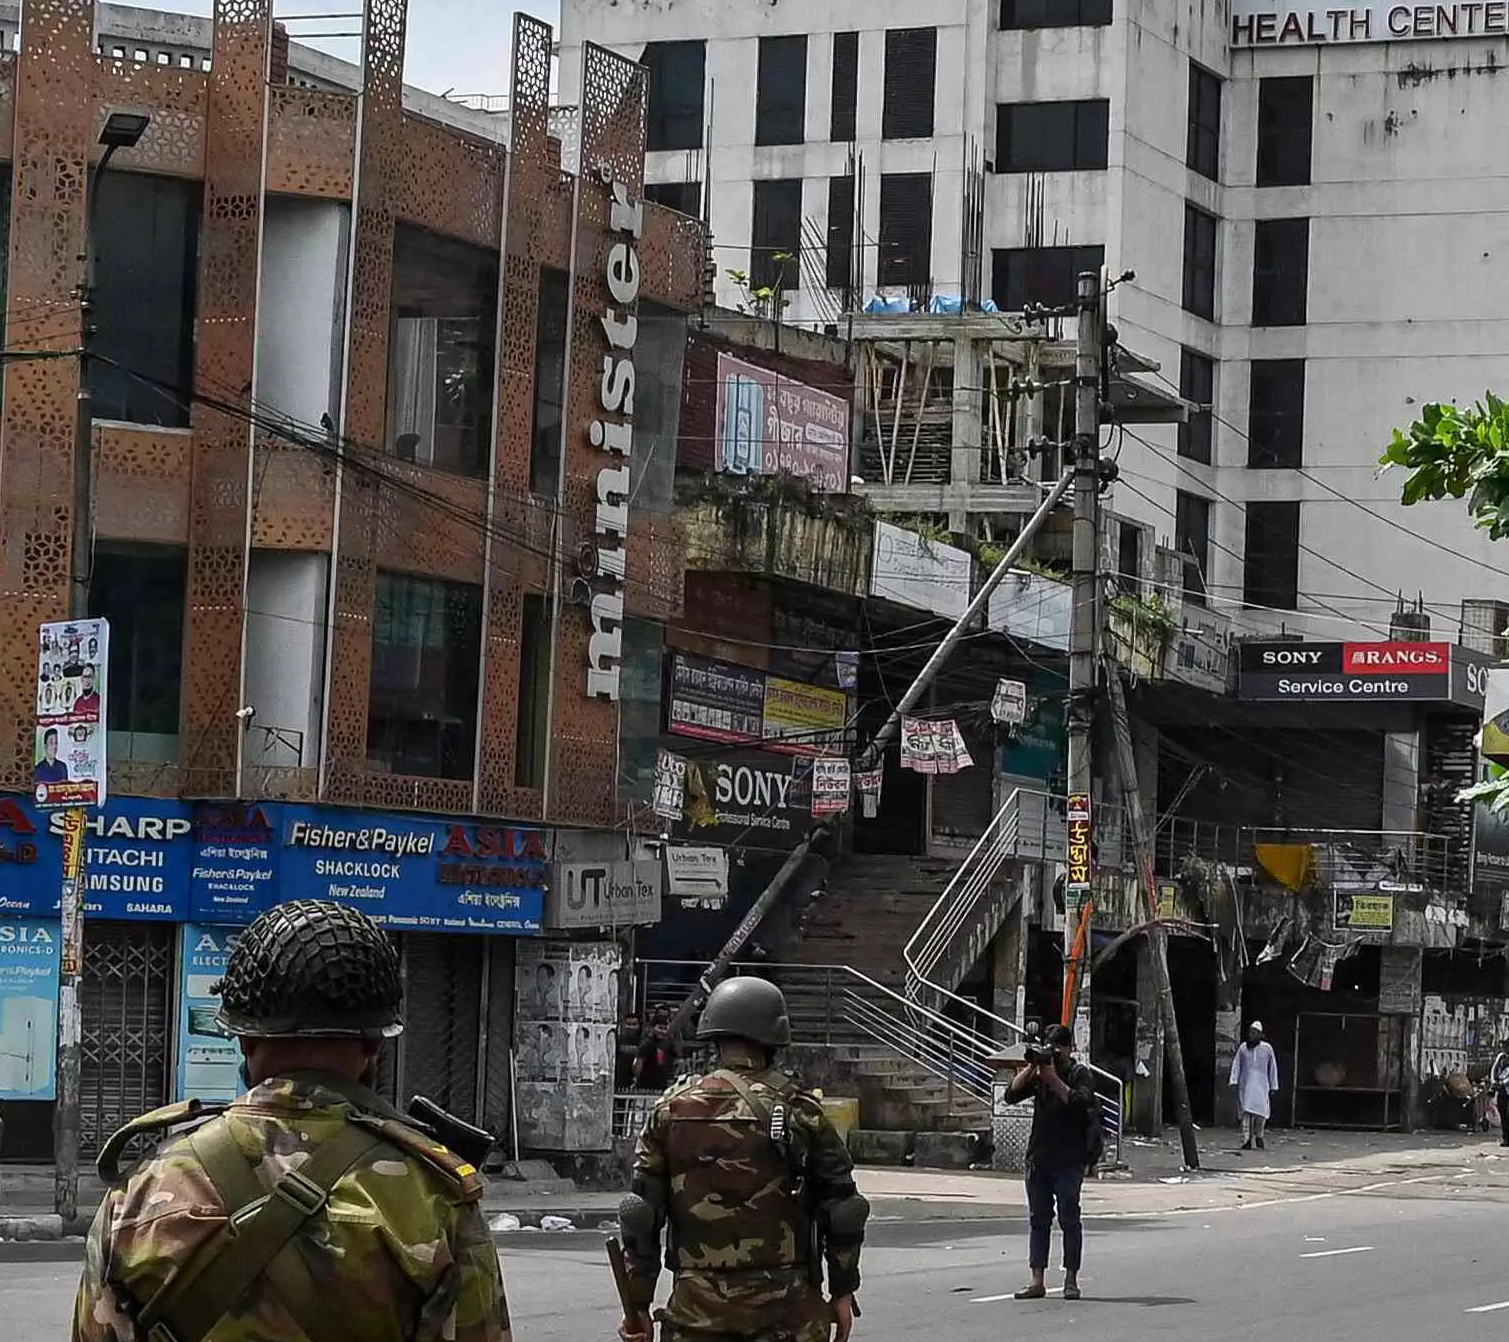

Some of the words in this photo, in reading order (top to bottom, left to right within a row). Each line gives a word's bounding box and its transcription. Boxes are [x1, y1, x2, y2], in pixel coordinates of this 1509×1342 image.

[1231, 8, 1372, 46] HEALTH
[586, 180, 645, 702] minister
[1262, 651, 1323, 665] SONY
[1278, 678, 1343, 694] Service
[1349, 678, 1409, 694] Centre
[715, 762, 791, 808] SONY
[83, 848, 166, 867] ITACHI
[314, 859, 401, 880] SHACKLOCK
[81, 872, 166, 893] AMSUNG
[328, 883, 350, 898] New
[350, 885, 386, 900] Zealand
[125, 902, 173, 915] SAHARA
[194, 933, 243, 953] AS
[193, 956, 228, 967] ELECT
